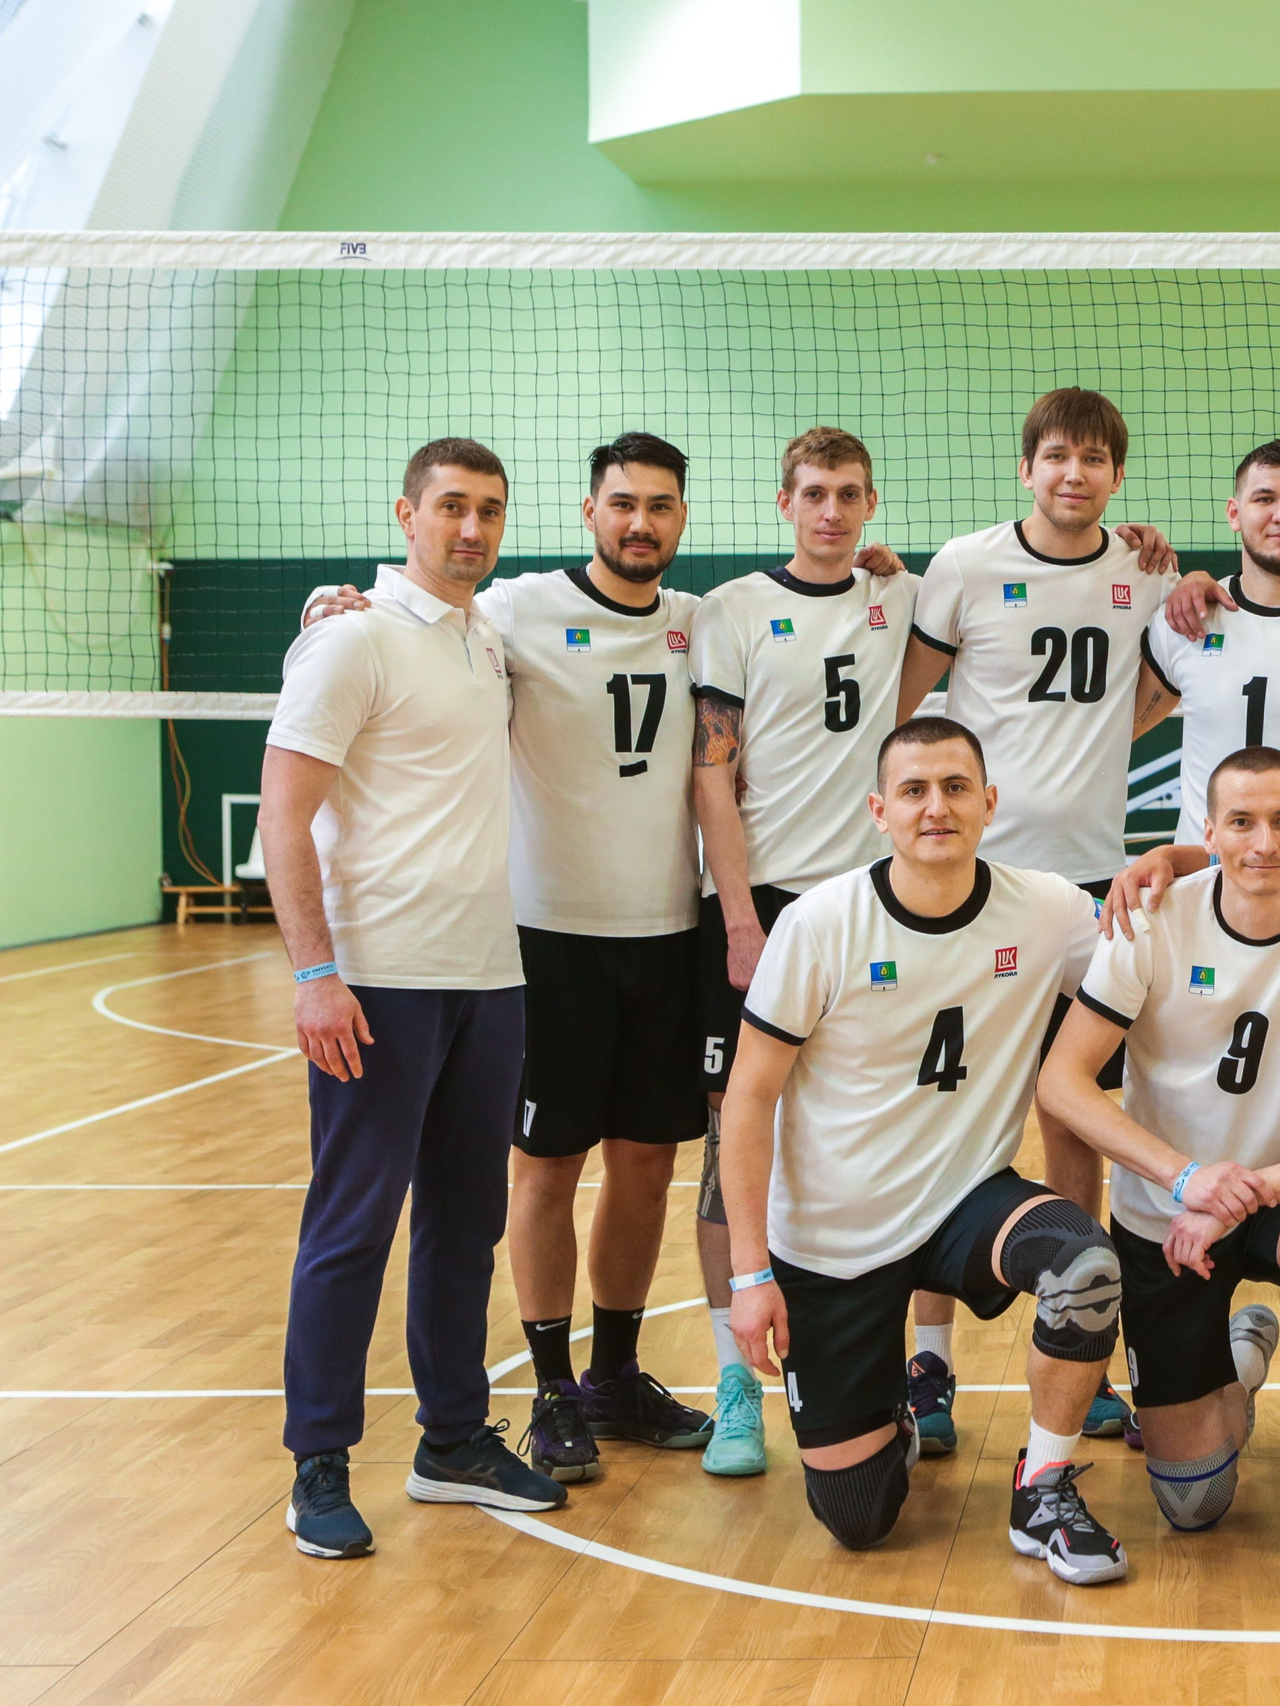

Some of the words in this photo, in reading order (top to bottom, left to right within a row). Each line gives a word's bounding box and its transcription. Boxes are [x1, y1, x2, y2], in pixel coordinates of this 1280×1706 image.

[340, 242, 367, 255] FIVB
[1113, 586, 1130, 603] LUK
[870, 607, 885, 624] LUK
[1028, 626, 1110, 703] 20
[606, 673, 667, 753] 17
[823, 653, 861, 733] 5
[1242, 676, 1268, 748] 1
[994, 971, 1018, 979] ЛУКОЙЛ
[998, 949, 1016, 969] LUK
[703, 1036, 726, 1074] 5
[917, 1005, 967, 1092] 4
[1217, 1010, 1270, 1095] 9
[1128, 1346, 1139, 1387] 9
[787, 1371, 803, 1413] 4
